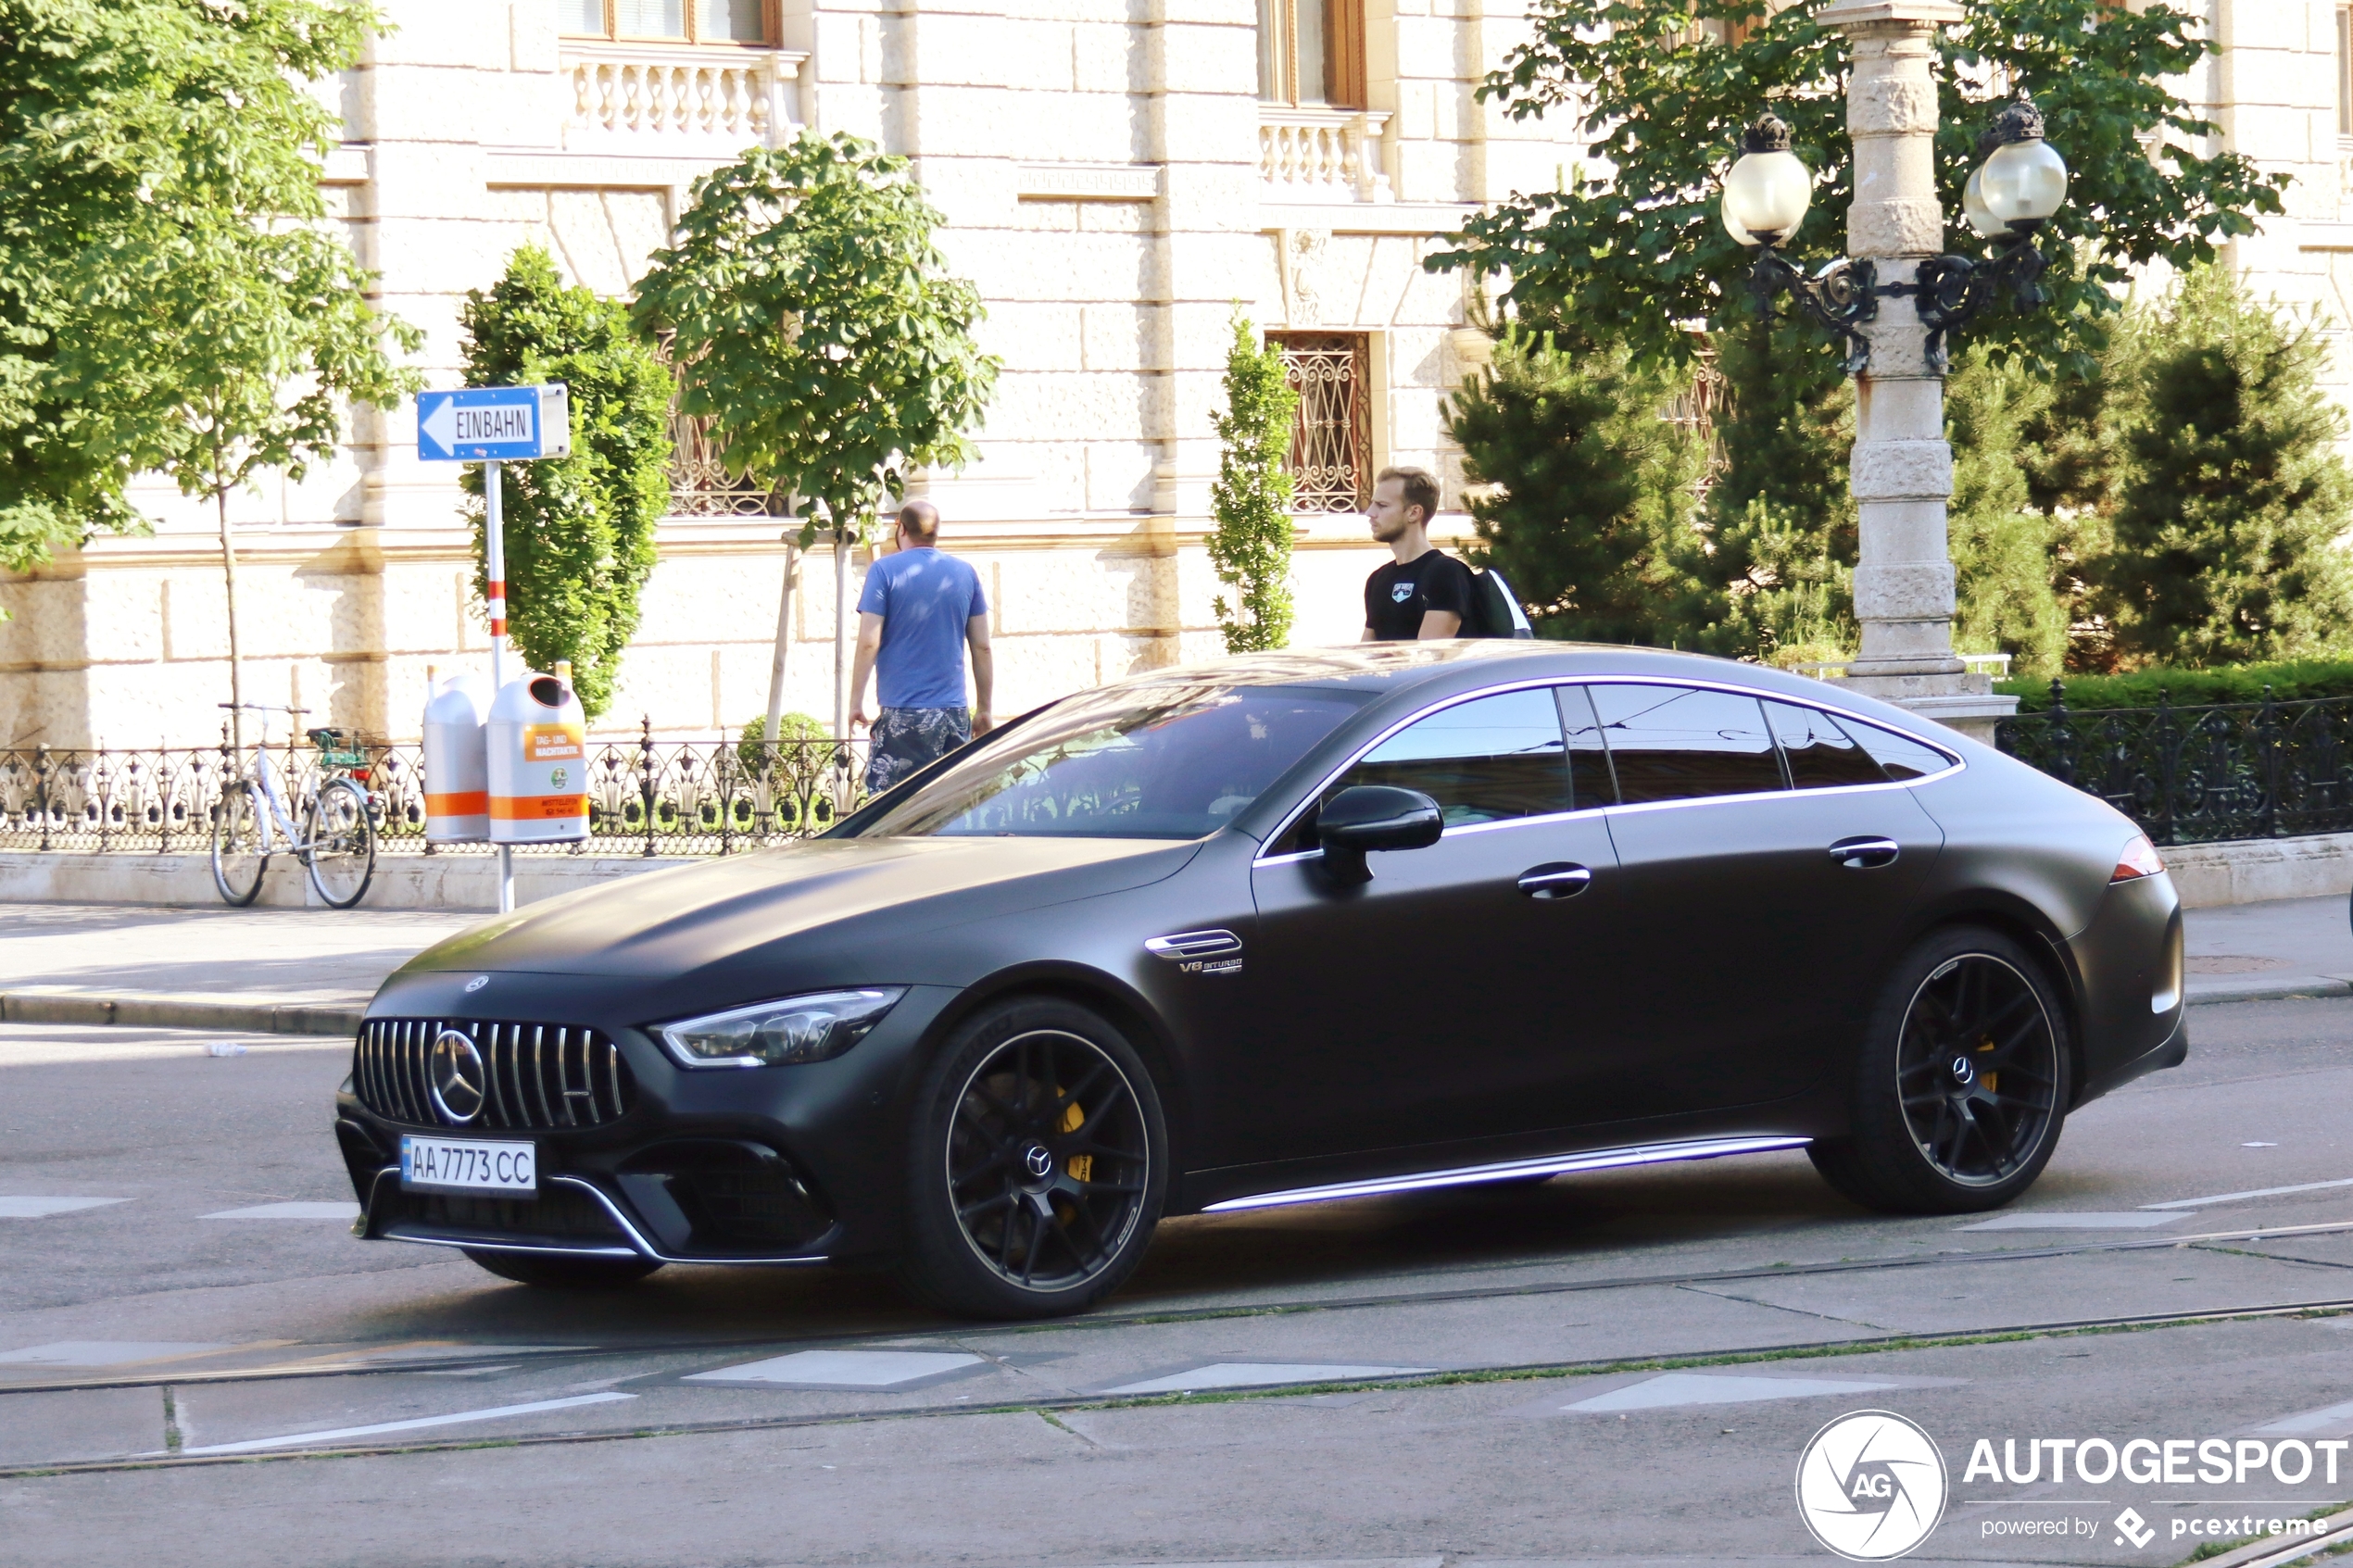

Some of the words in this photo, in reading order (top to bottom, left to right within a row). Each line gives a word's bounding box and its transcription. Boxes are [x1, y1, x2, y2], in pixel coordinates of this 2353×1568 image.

[457, 409, 526, 439] EINBAHN
[535, 735, 552, 746] TAG-
[553, 734, 567, 744] UND
[1179, 961, 1202, 972] V8
[1203, 958, 1242, 969] BITURBO
[413, 1145, 437, 1178] AA
[441, 1147, 491, 1182] 7773
[497, 1150, 531, 1184] CC
